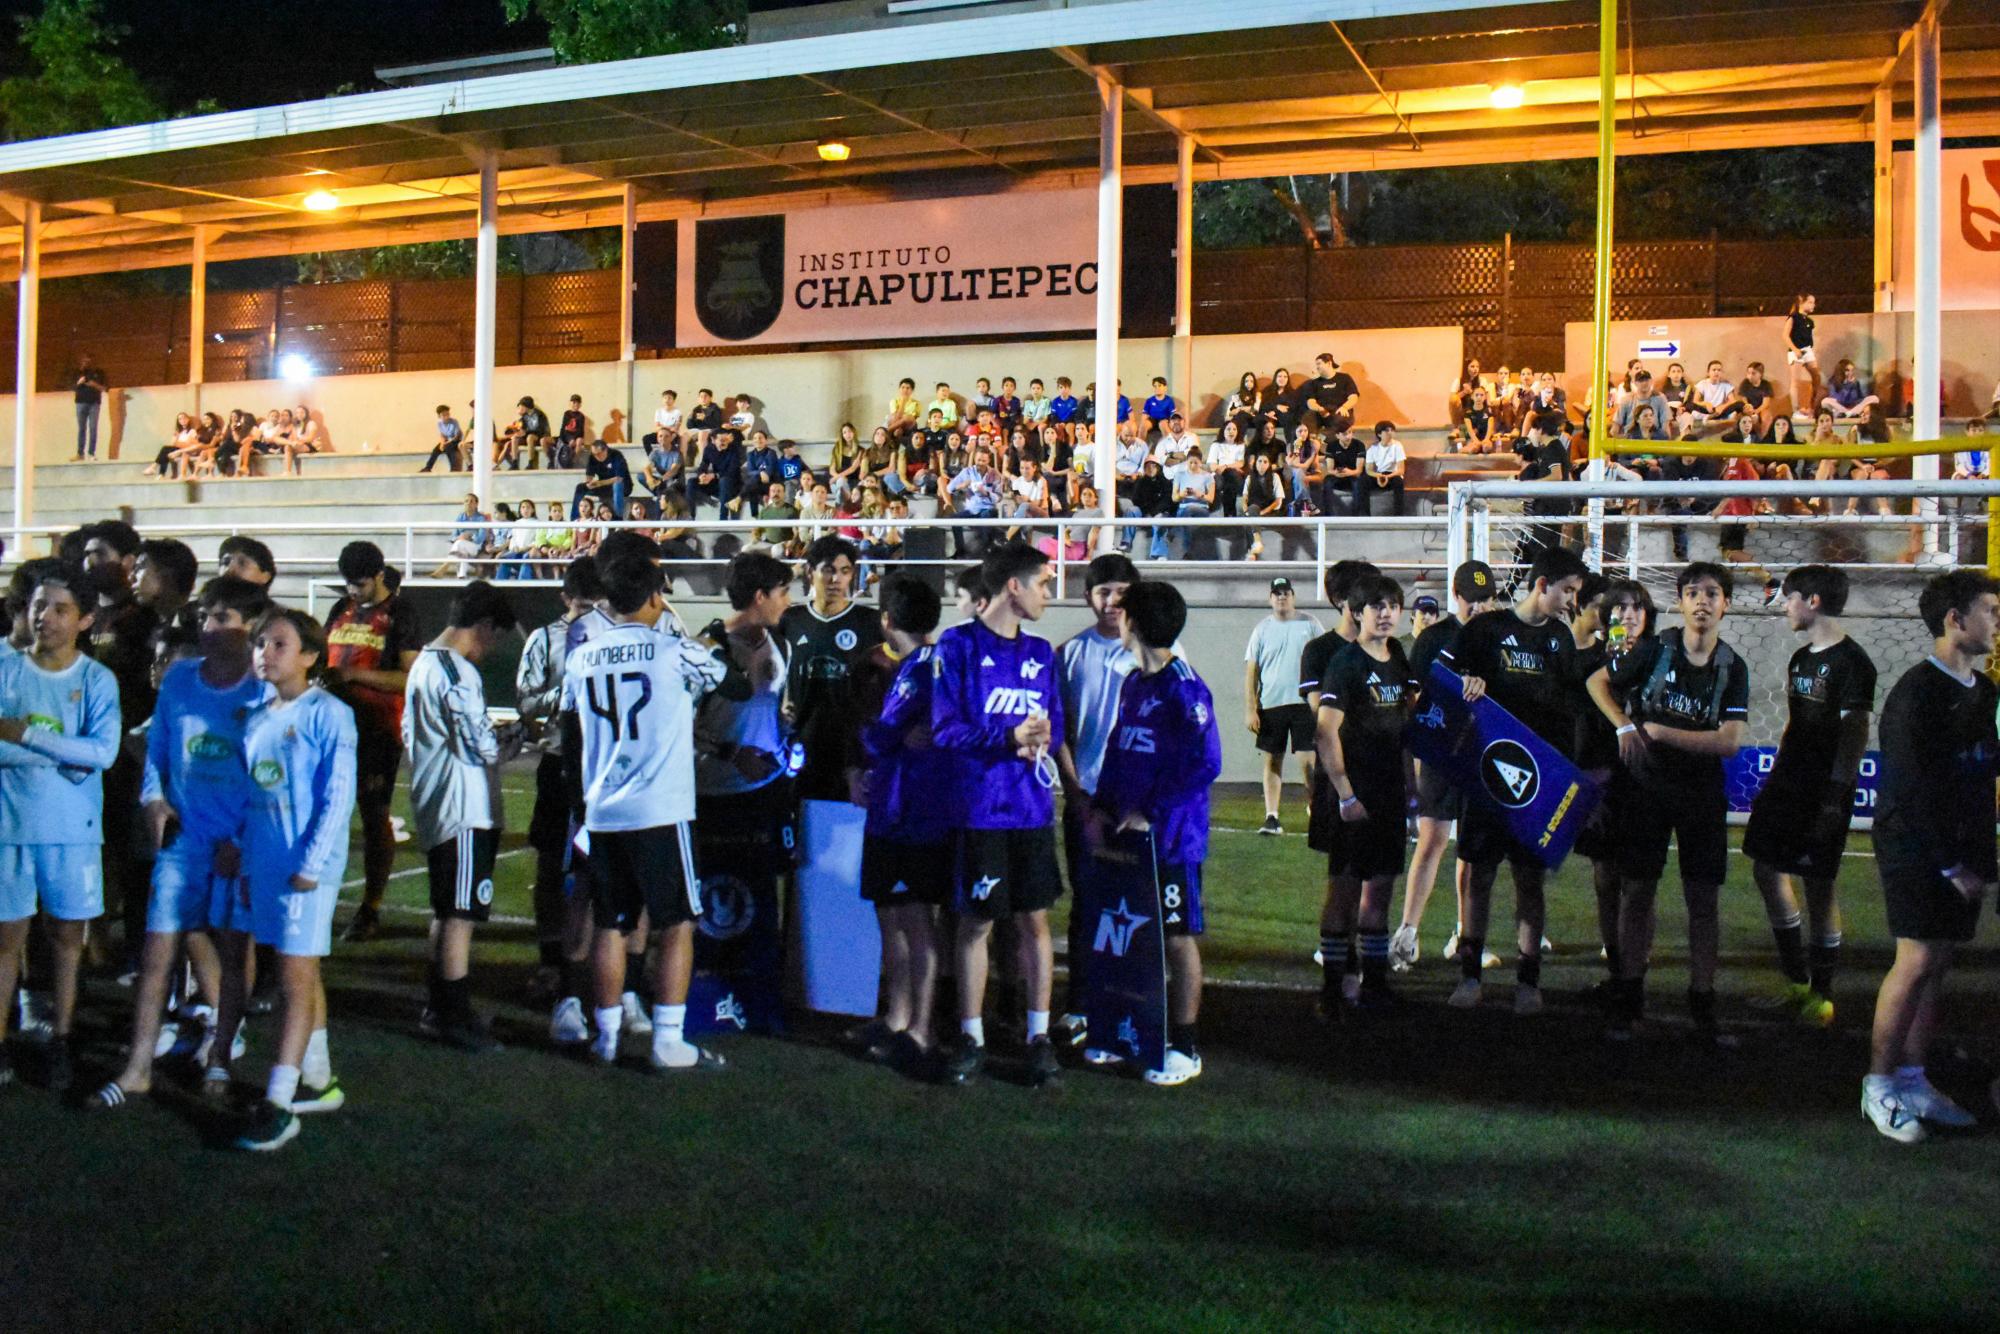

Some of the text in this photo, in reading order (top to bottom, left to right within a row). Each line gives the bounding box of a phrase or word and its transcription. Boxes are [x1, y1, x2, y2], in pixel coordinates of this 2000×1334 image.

[799, 245, 951, 272] INSTITUTO
[795, 262, 1098, 309] CHAPULTEPEC
[585, 671, 653, 742] 47
[1164, 884, 1181, 908] 8
